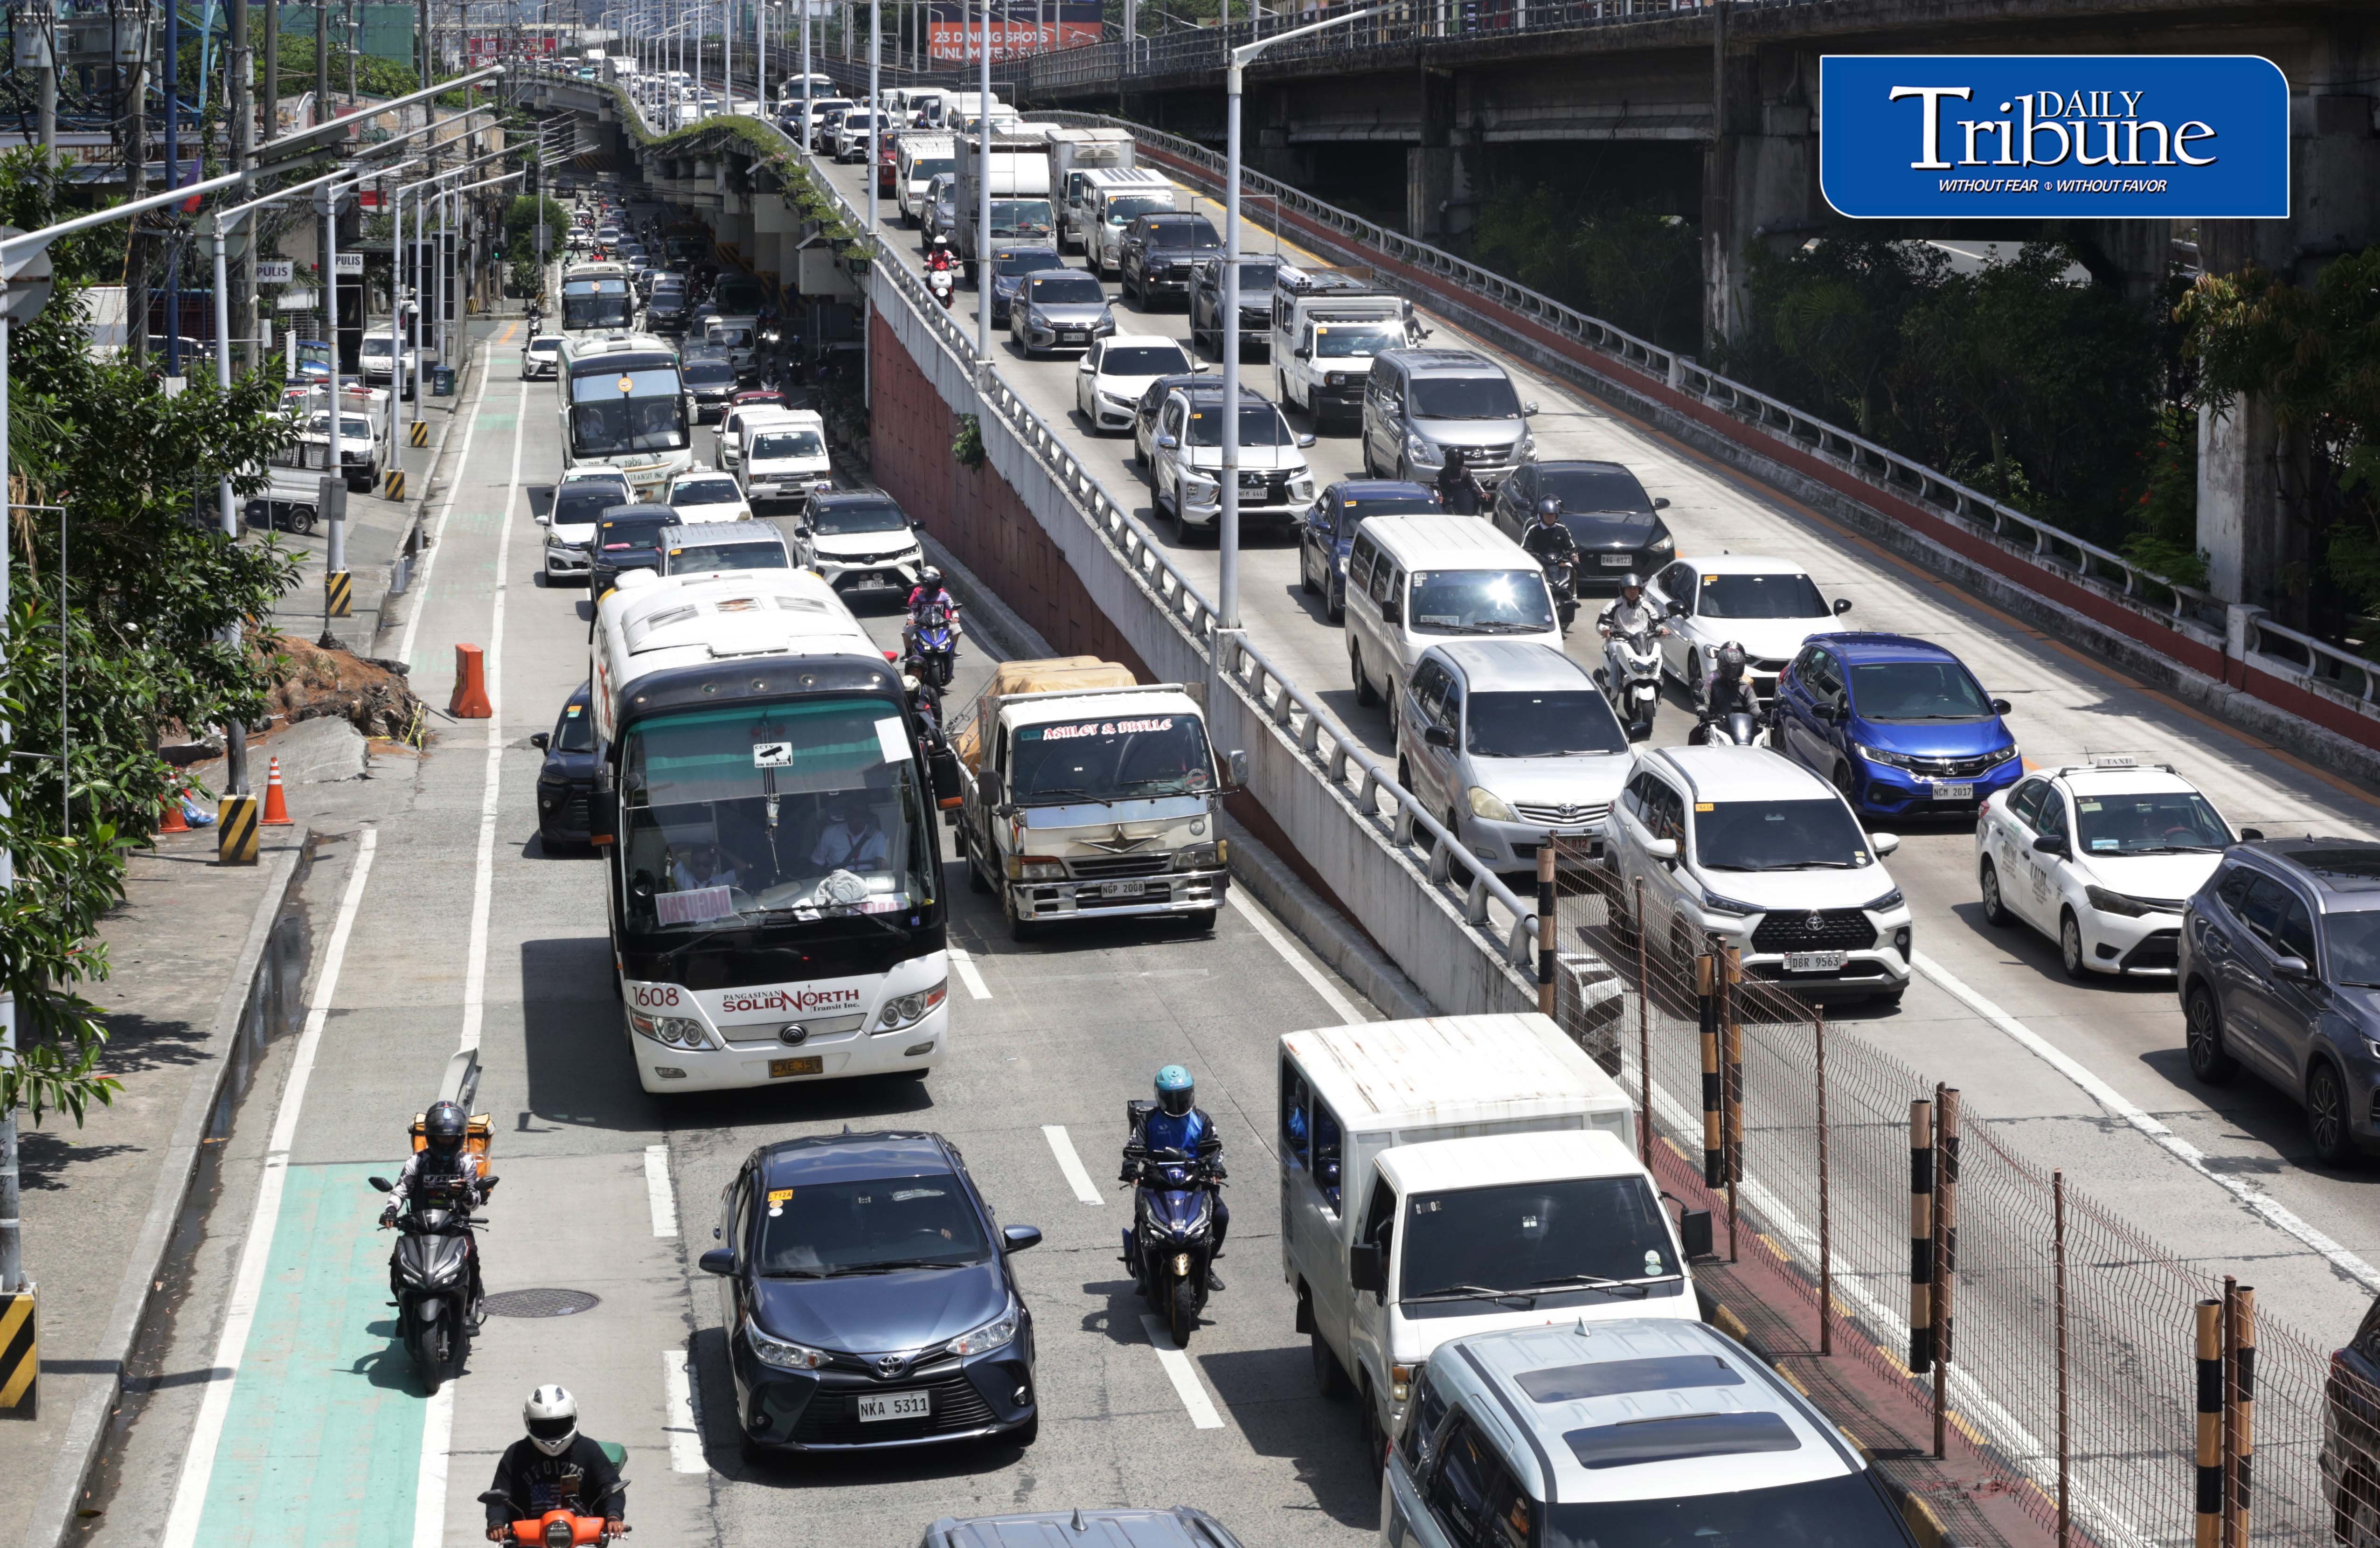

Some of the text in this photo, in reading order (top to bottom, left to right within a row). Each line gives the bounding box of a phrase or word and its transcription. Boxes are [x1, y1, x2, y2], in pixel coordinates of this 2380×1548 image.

[934, 32, 950, 42] 23
[954, 32, 1002, 42] DNIG
[336, 256, 361, 265] PULIS
[257, 267, 288, 277] PULIS
[1616, 555, 1631, 564] 6123
[1101, 723, 1117, 735] &
[1934, 787, 1972, 796] NCM 2017
[1103, 883, 1143, 895] NGP 2008
[1792, 956, 1839, 968] DBR 9563
[632, 986, 680, 1007] 1608
[724, 990, 781, 1001] PANGASINAN
[860, 1397, 928, 1416] NKA 5311
